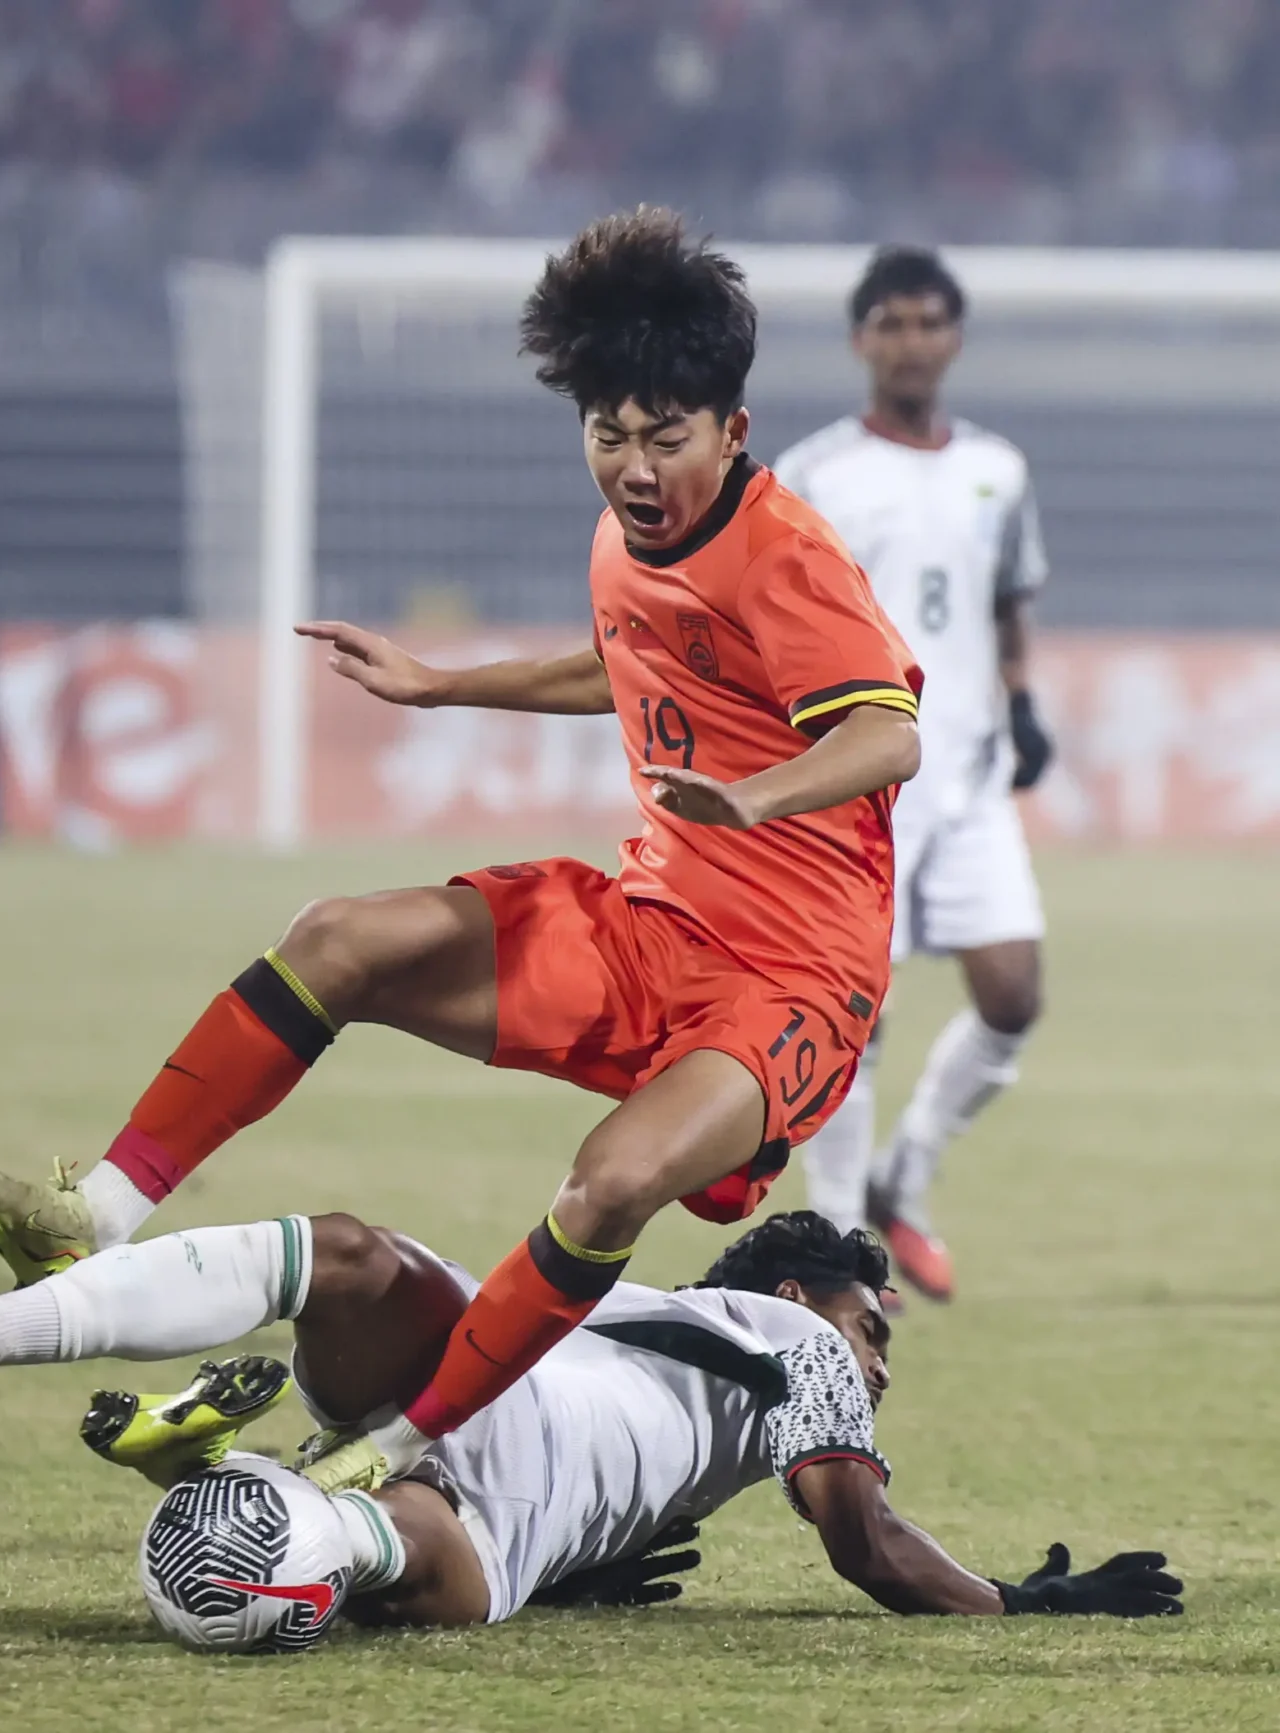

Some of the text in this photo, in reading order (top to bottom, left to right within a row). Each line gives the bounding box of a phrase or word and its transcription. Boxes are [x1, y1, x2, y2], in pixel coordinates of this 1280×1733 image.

[917, 566, 949, 634] 8
[639, 696, 695, 770] 19
[767, 1006, 817, 1107] 19
